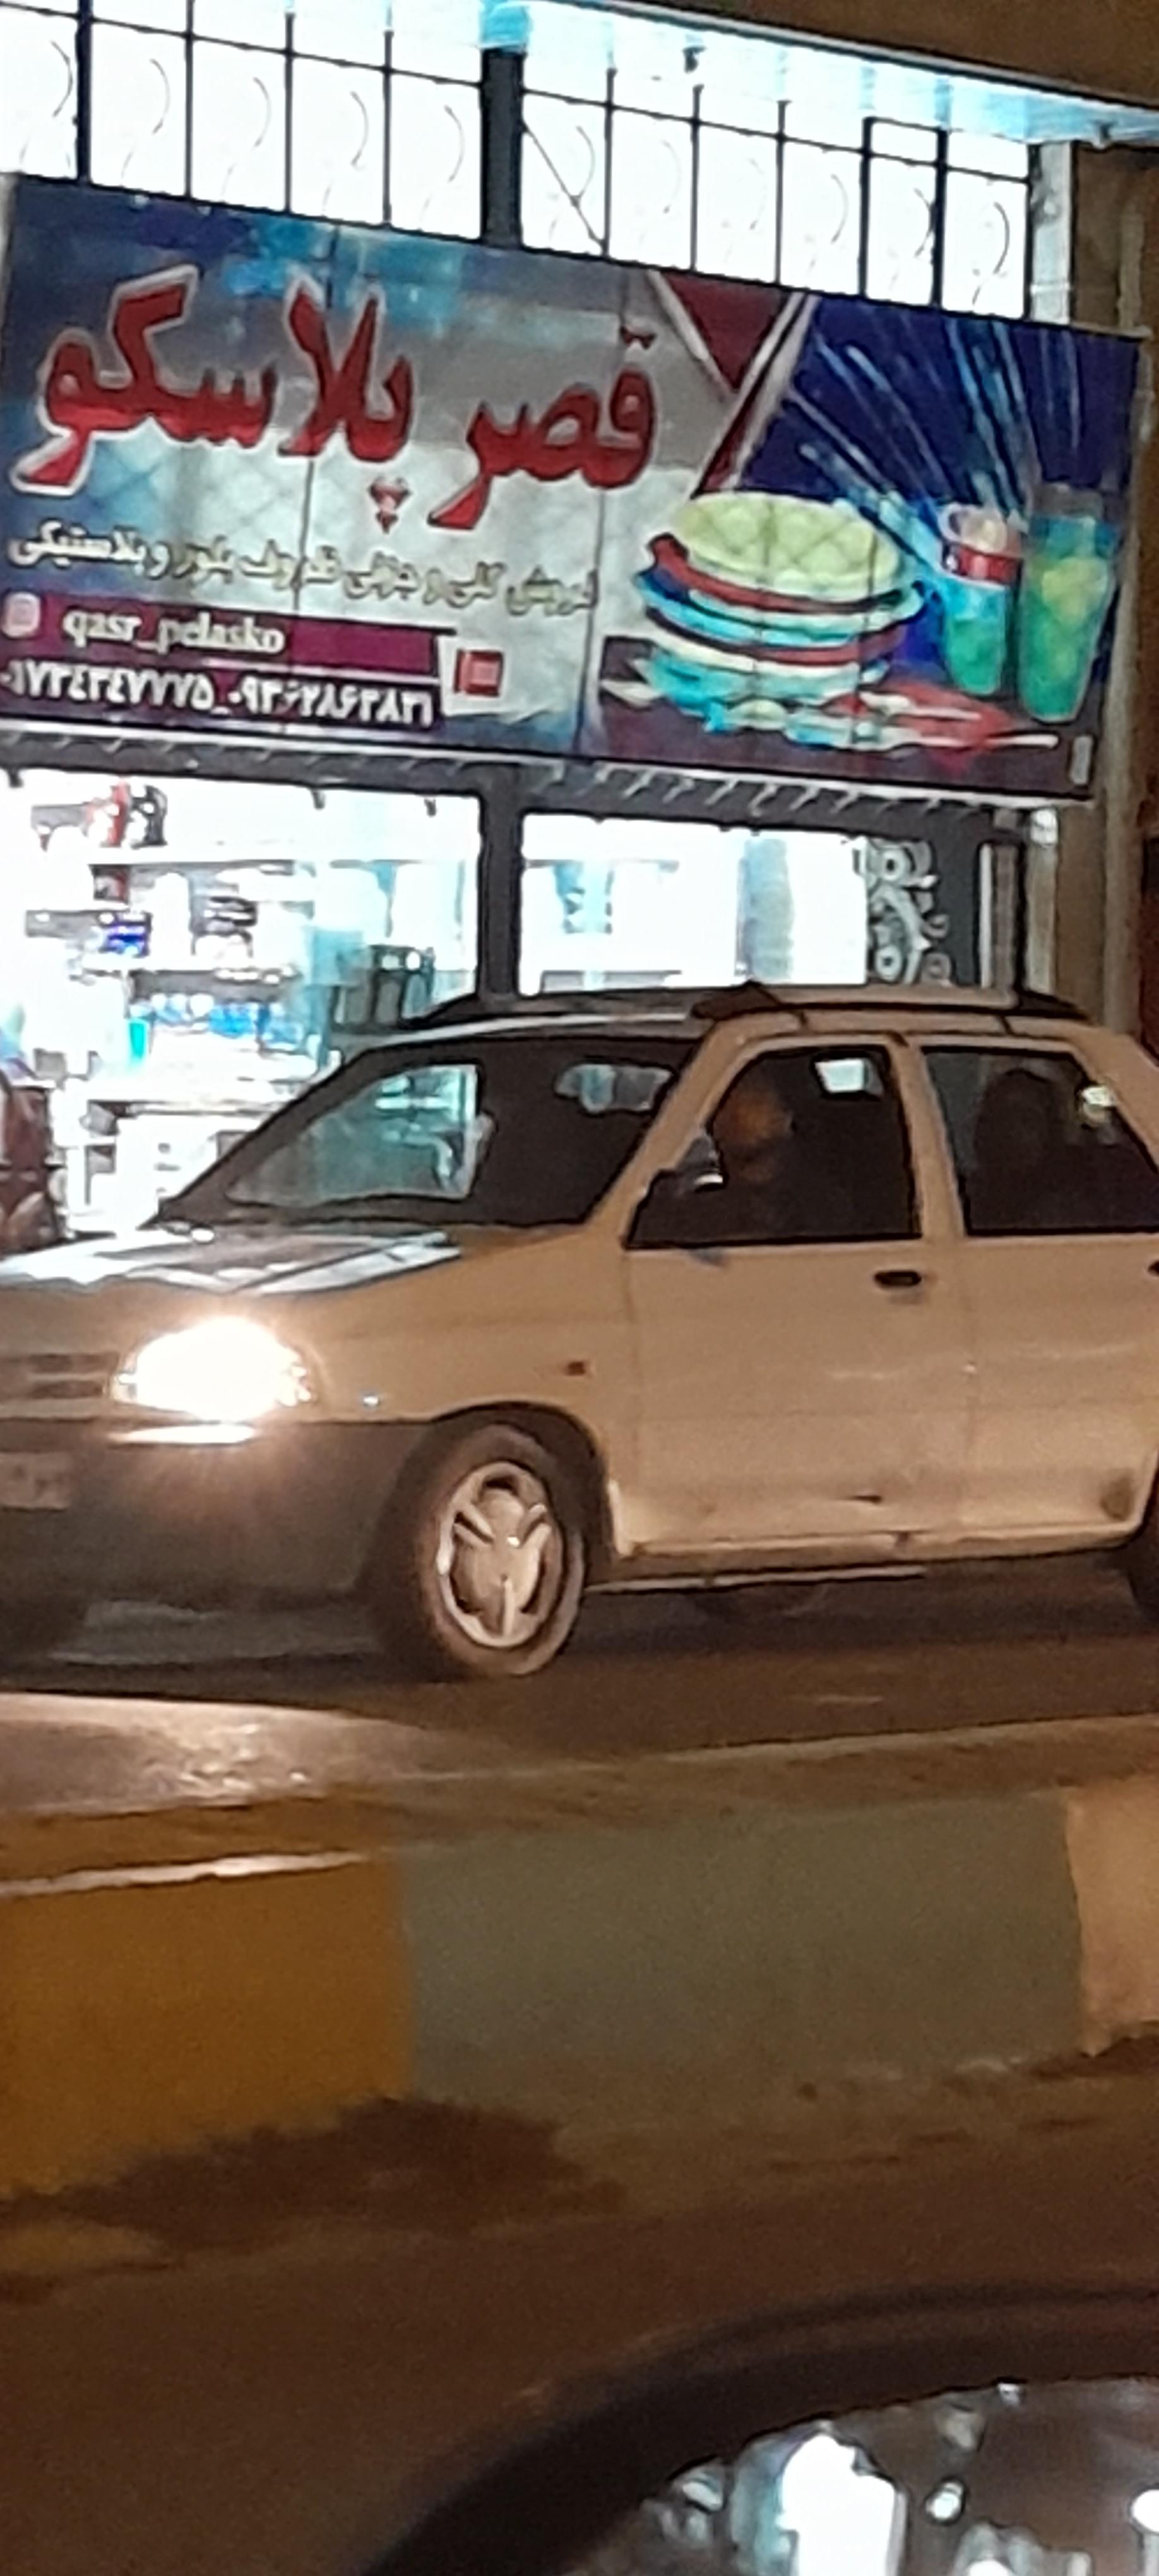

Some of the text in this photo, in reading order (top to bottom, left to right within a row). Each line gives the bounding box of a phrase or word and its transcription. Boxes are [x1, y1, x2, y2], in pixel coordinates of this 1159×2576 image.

[9, 262, 659, 534] قصر پلاسکو
[6, 518, 147, 578] پلاستیکی
[144, 538, 172, 580] و
[172, 534, 236, 587] بلور
[422, 566, 444, 606] و
[444, 560, 507, 610] کلی
[62, 609, 286, 655] qasr_pelasko
